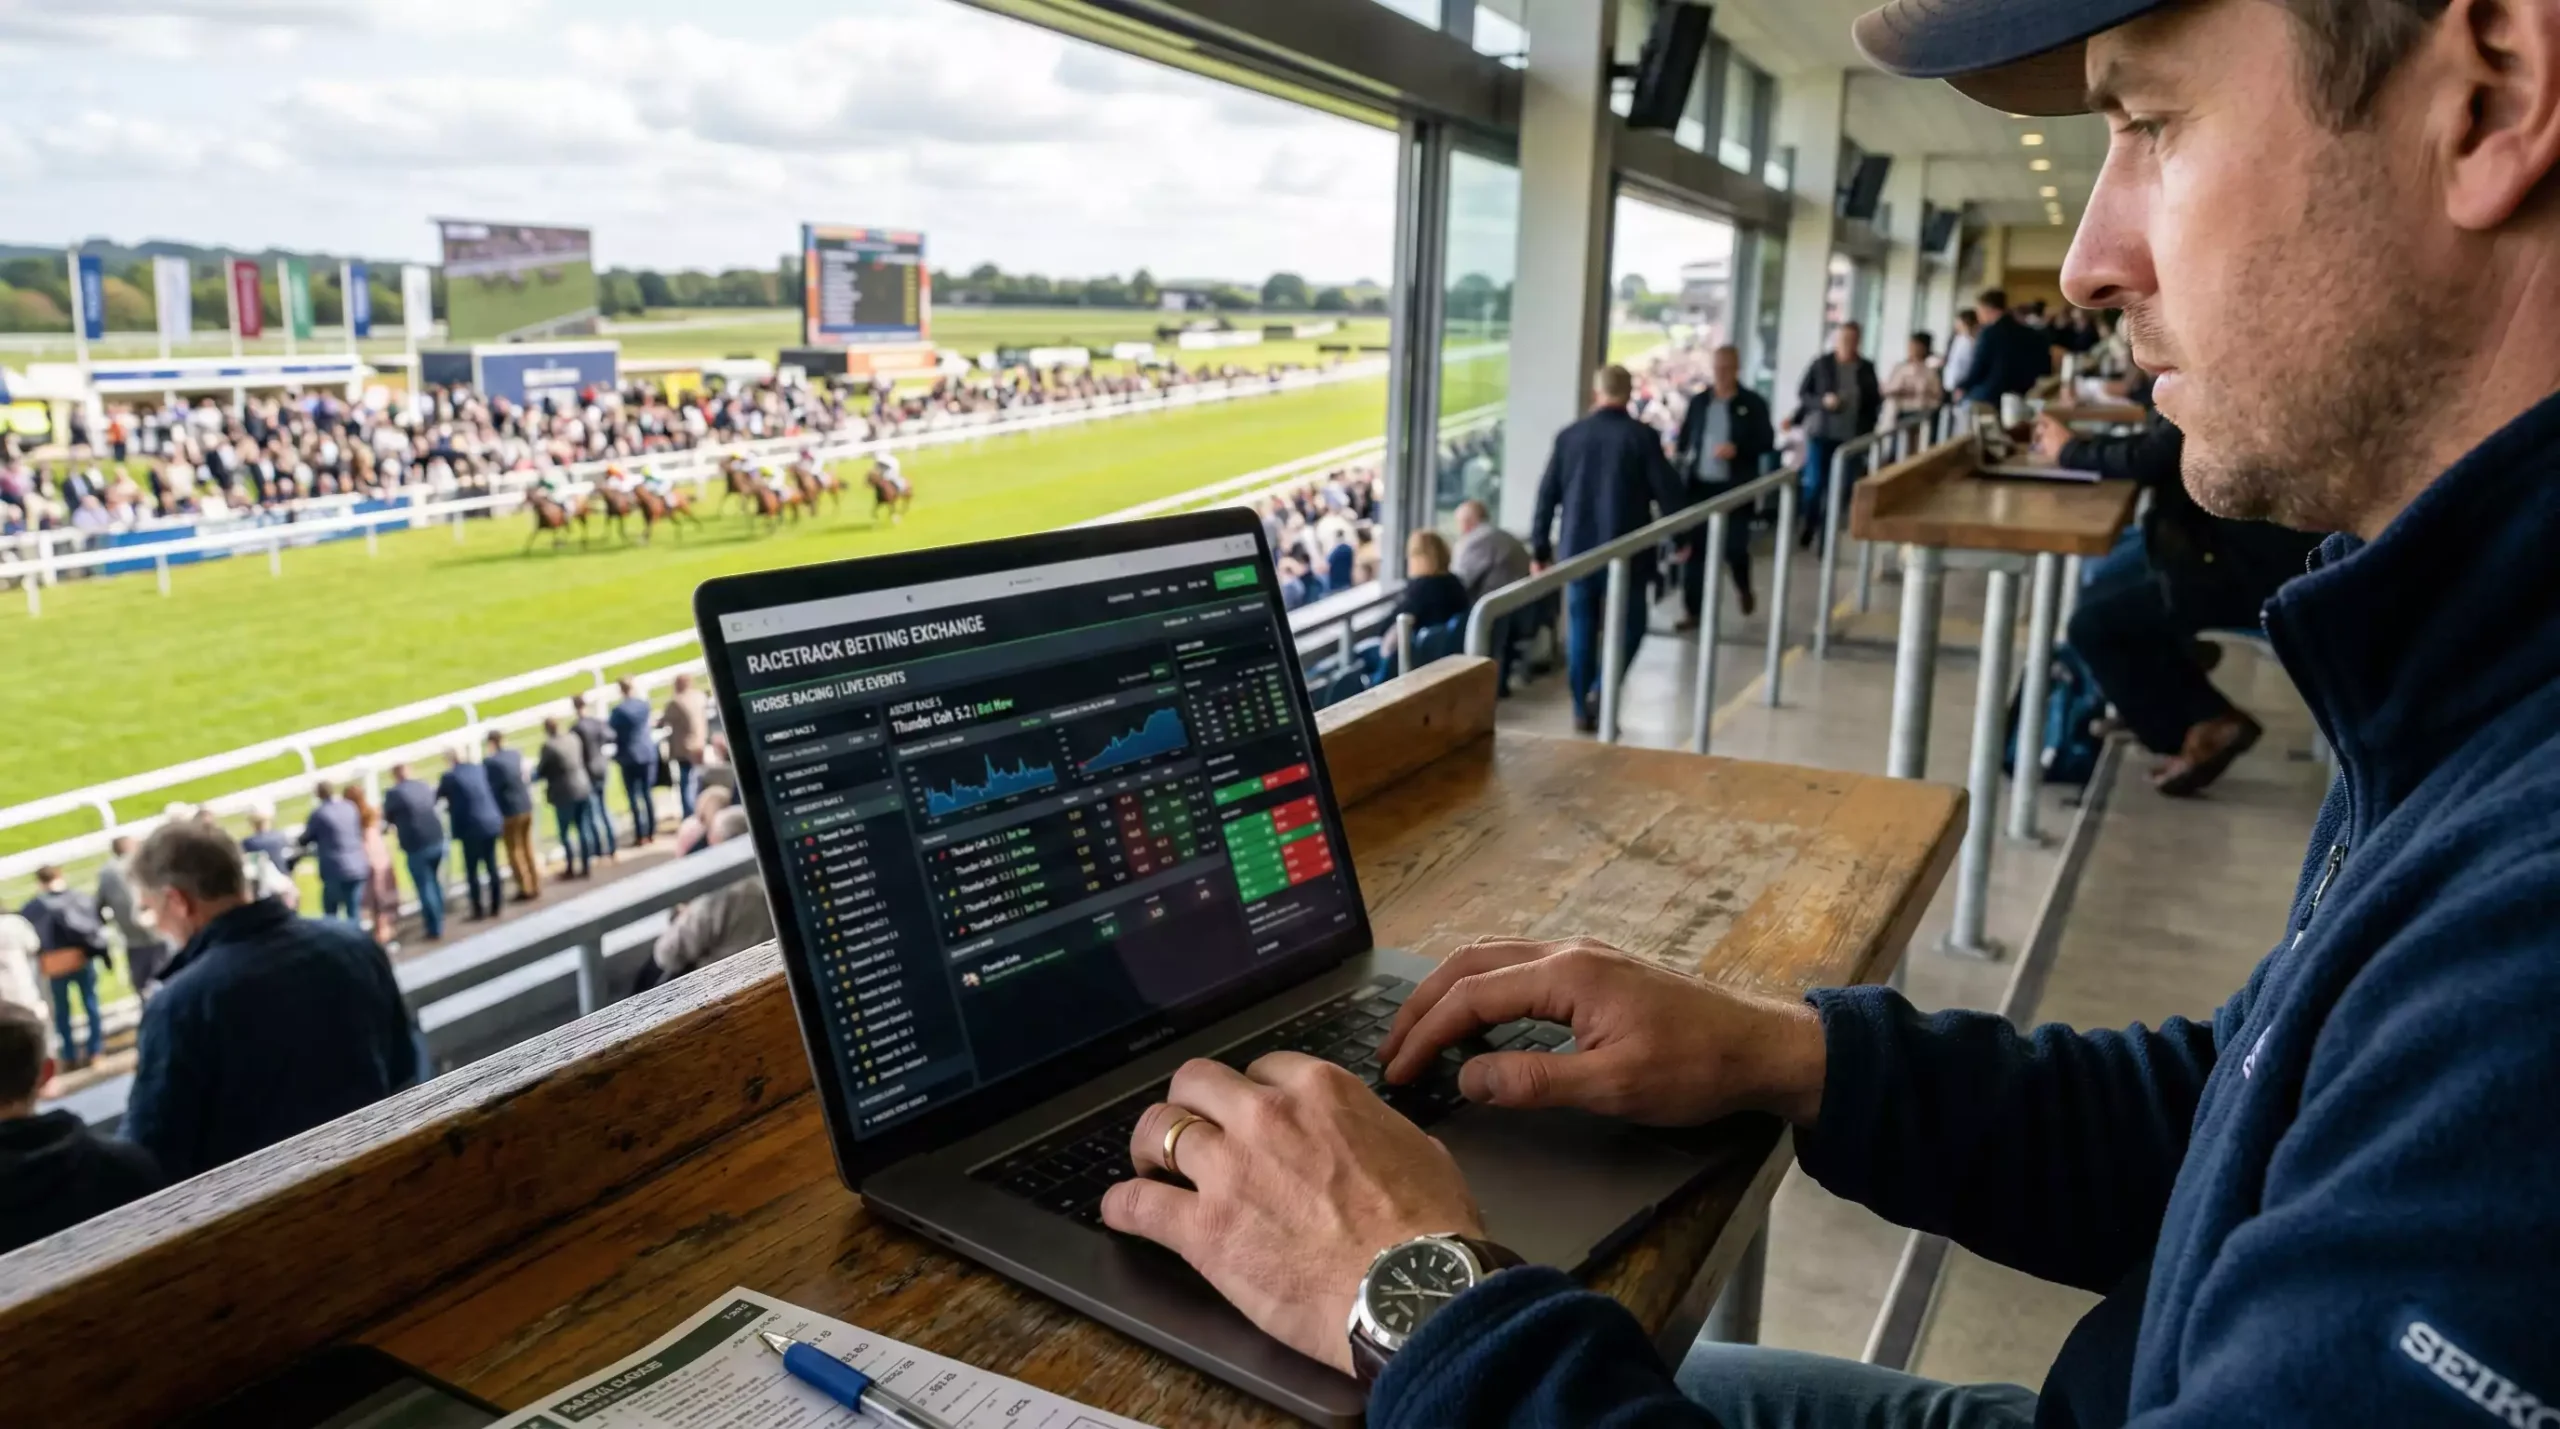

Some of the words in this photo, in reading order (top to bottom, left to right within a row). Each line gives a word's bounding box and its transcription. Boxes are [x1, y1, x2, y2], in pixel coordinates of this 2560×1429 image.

[746, 639, 844, 674] RACETRACK
[845, 629, 910, 656] BETTING
[911, 614, 986, 645] EXCHANGE
[752, 693, 792, 714] HORSE
[792, 684, 834, 706] RACING
[841, 677, 867, 696] LIVE
[866, 670, 906, 692] EVENTS
[892, 712, 932, 735] Thunder
[954, 704, 972, 722] 5.2
